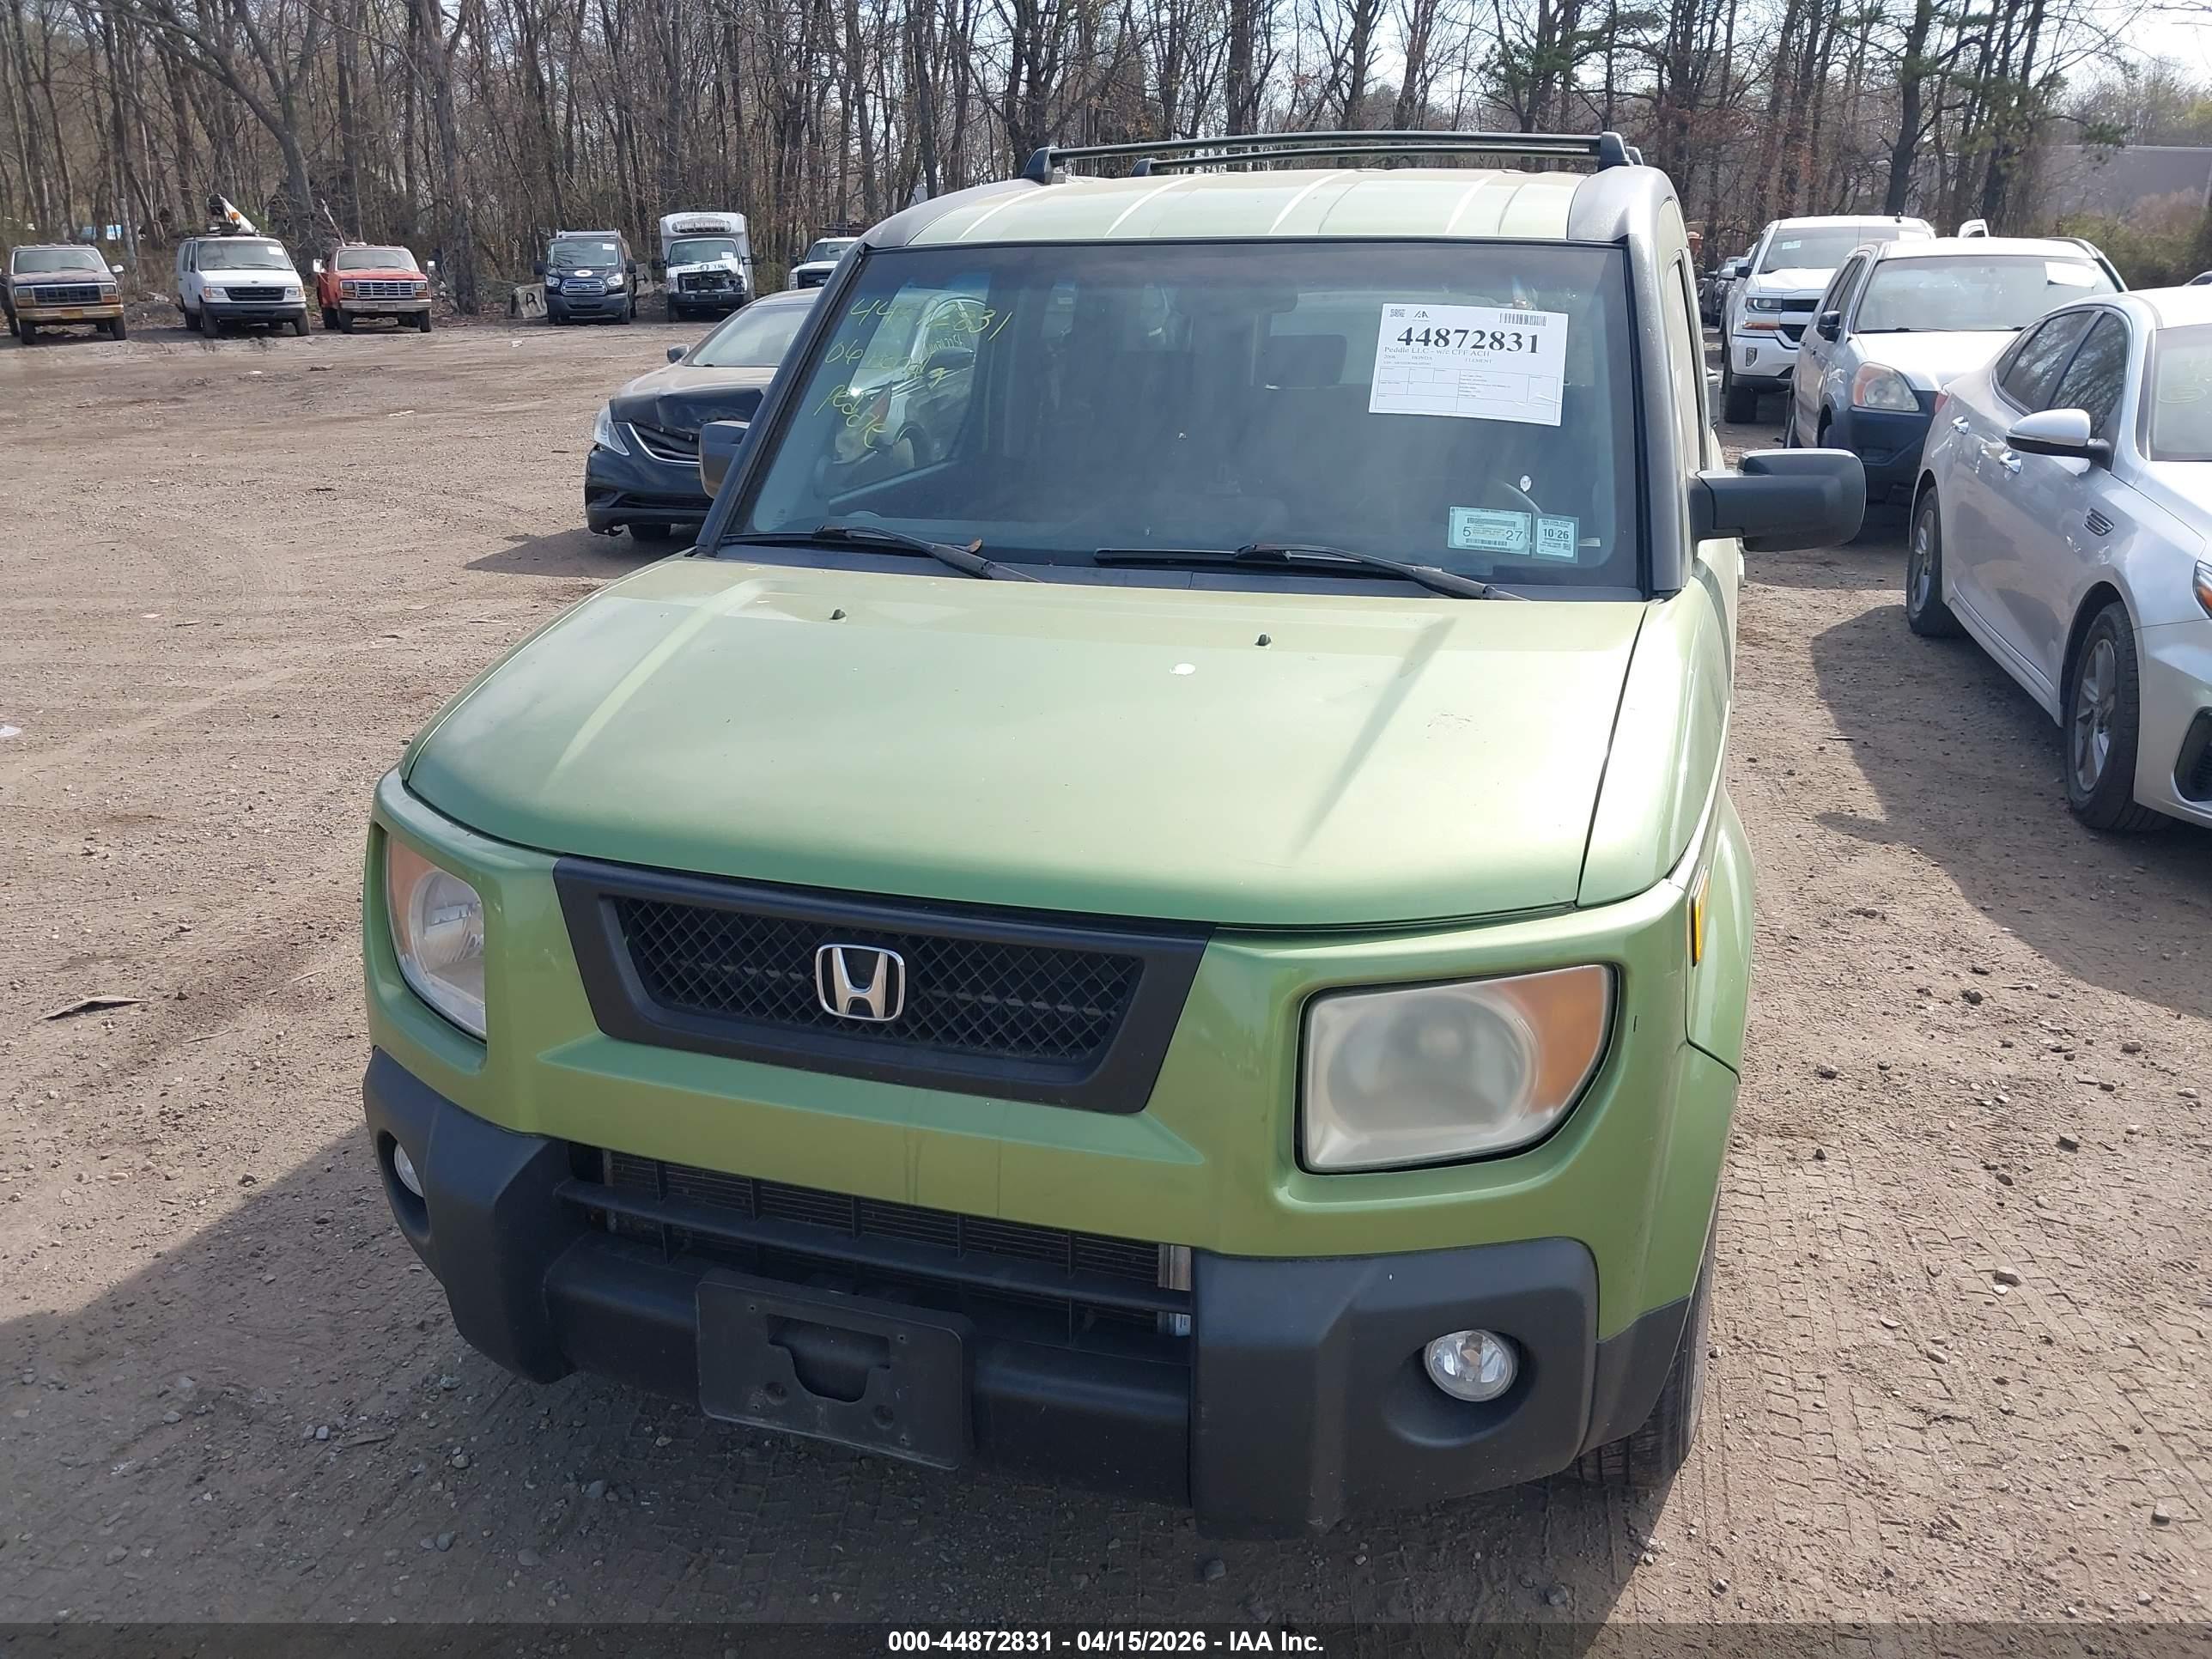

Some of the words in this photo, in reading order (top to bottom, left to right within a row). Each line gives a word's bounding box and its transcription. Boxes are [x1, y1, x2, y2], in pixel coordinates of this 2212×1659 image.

[825, 339, 864, 365] 06
[1397, 327, 1540, 354] 44872831
[1462, 526, 1472, 537] 5
[1506, 530, 1523, 541] 27
